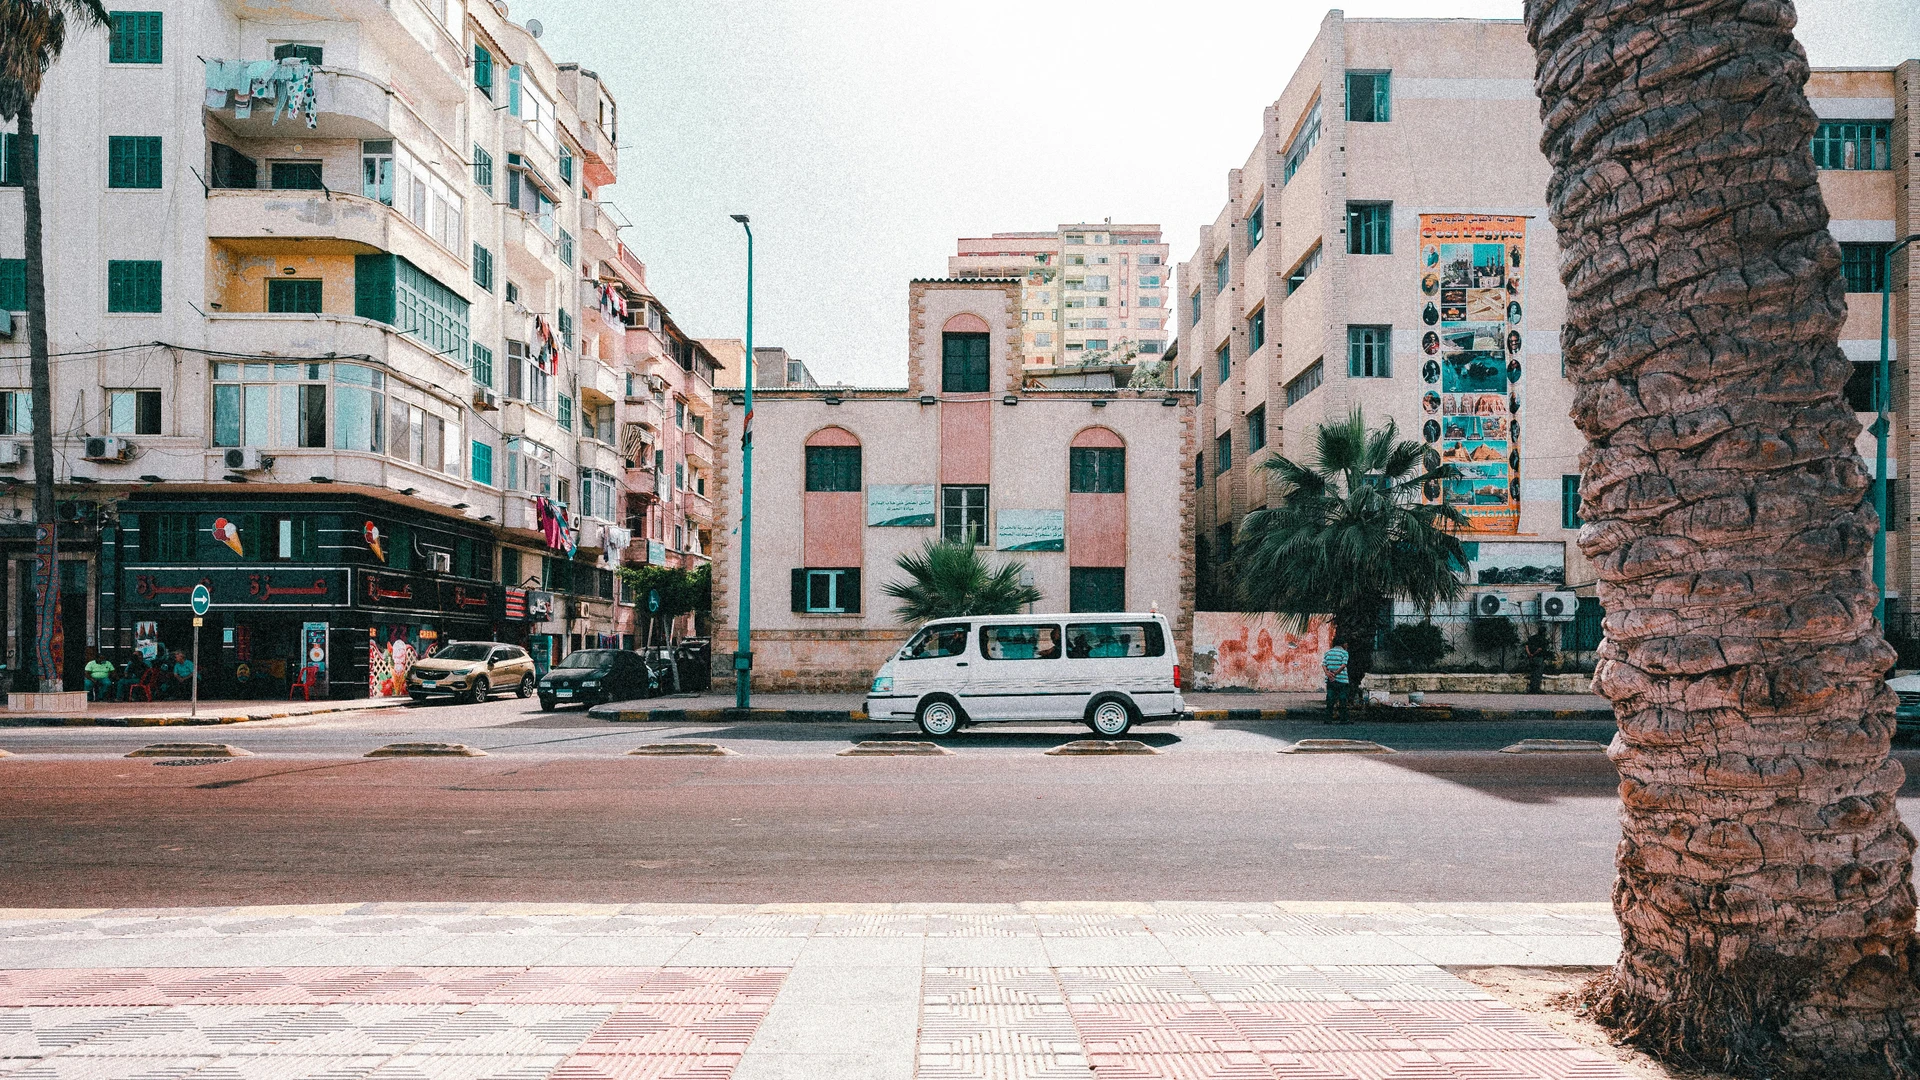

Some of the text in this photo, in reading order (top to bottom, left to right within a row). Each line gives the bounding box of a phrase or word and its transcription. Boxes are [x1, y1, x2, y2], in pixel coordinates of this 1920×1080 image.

[1422, 227, 1459, 239] C'est
[1461, 508, 1520, 518] Alexandri
[249, 573, 328, 601] عزة
